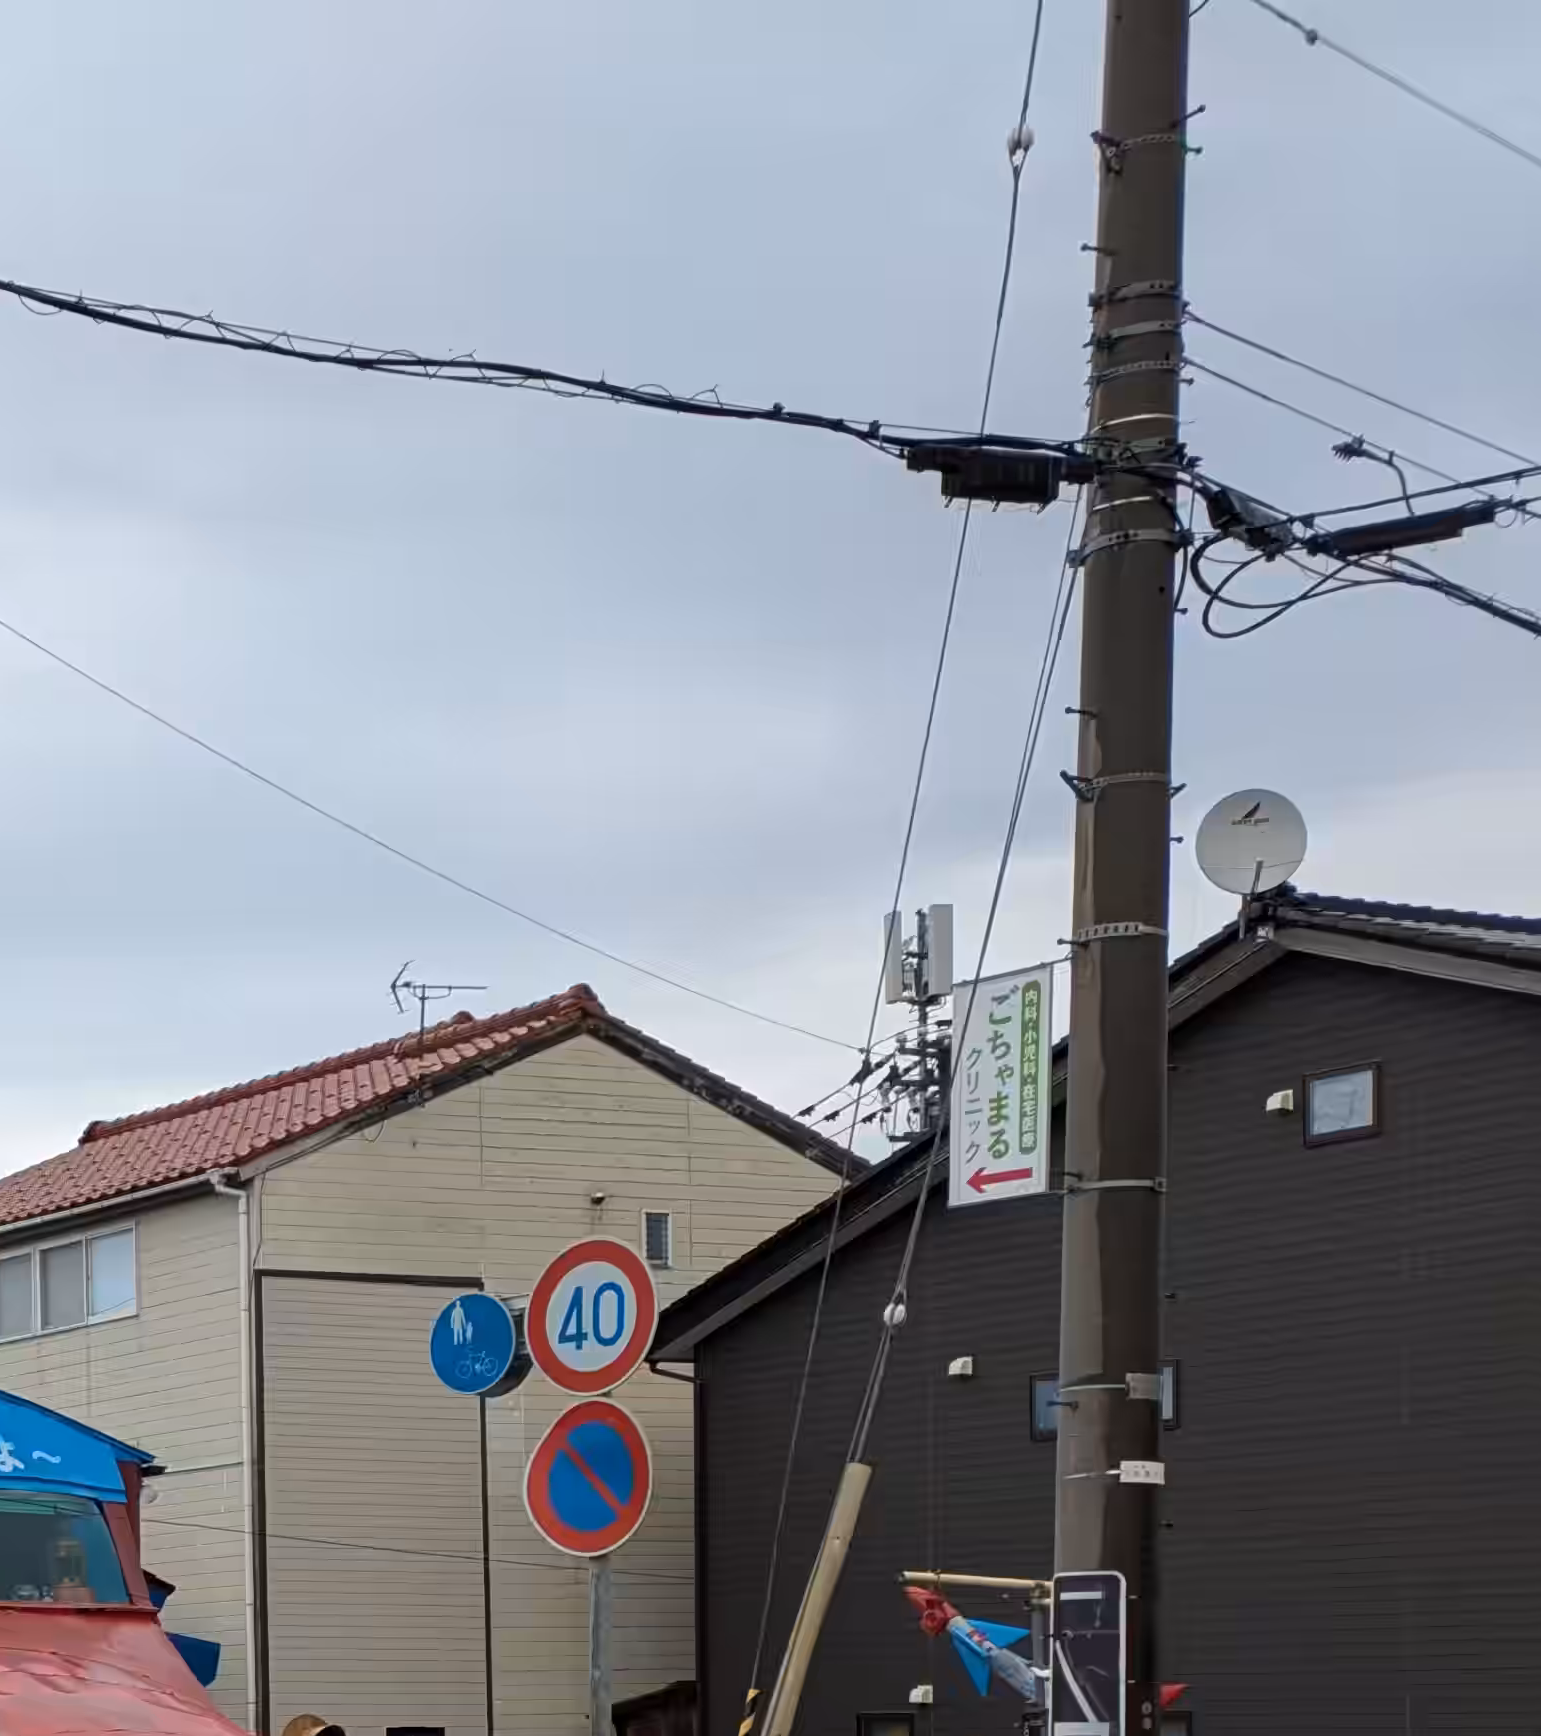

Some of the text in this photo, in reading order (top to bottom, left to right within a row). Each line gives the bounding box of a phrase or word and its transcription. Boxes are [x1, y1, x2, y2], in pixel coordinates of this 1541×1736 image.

[964, 1047, 983, 1164] クリニック
[986, 984, 1020, 1160] ごちゃまる
[558, 1282, 625, 1350] 40
